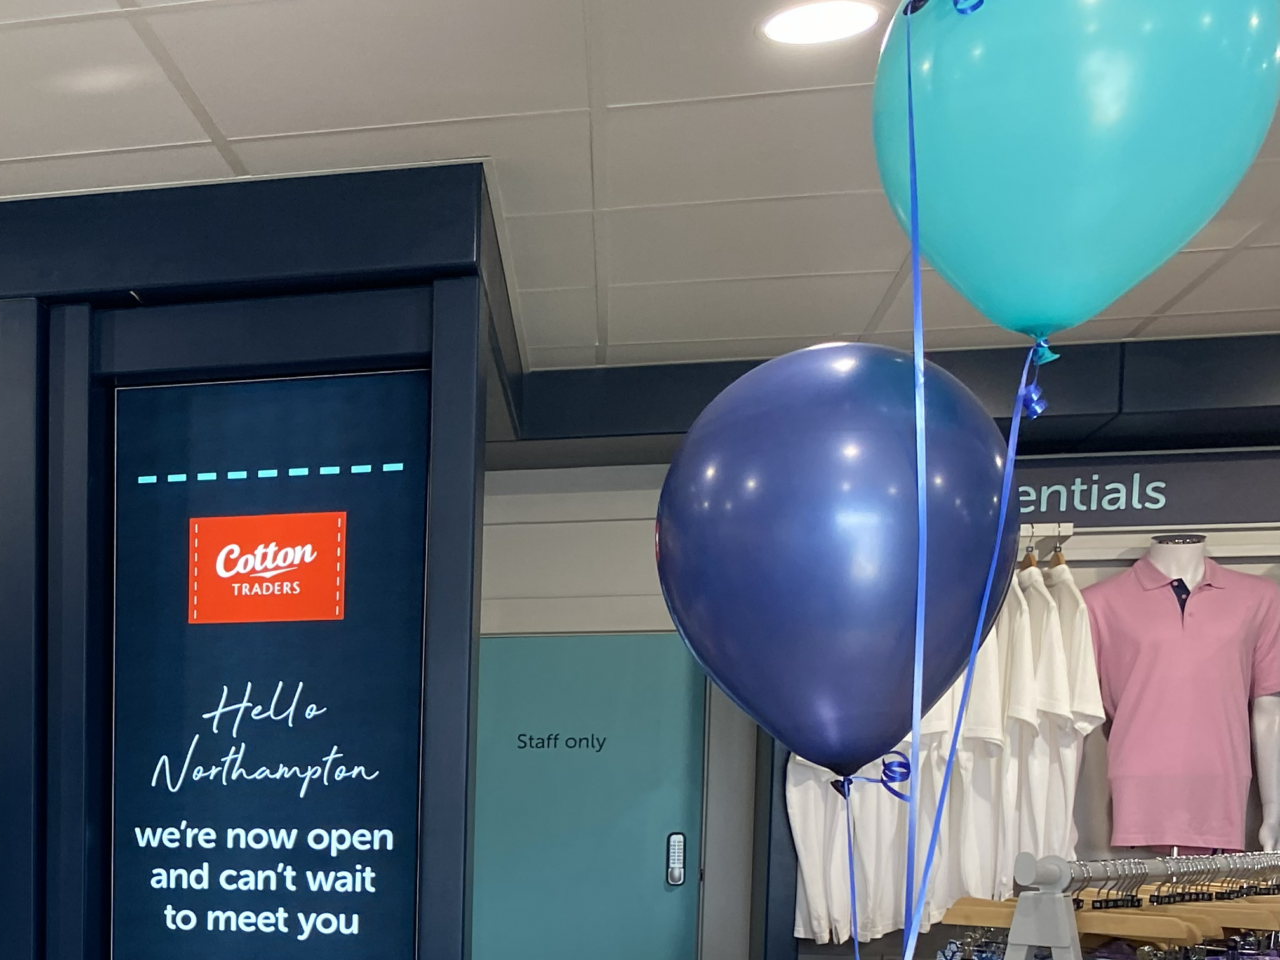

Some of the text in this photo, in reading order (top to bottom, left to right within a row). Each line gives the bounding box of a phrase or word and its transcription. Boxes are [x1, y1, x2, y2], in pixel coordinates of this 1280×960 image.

[1019, 473, 1165, 512] entials
[216, 542, 316, 577] Cotton
[232, 582, 299, 595] TRADERS
[202, 681, 326, 738] Hello
[518, 734, 606, 752] Staff only
[152, 732, 379, 798] Northampton
[135, 820, 393, 857] we're now open
[151, 862, 375, 892] and can't wait
[164, 905, 358, 940] to meet you
